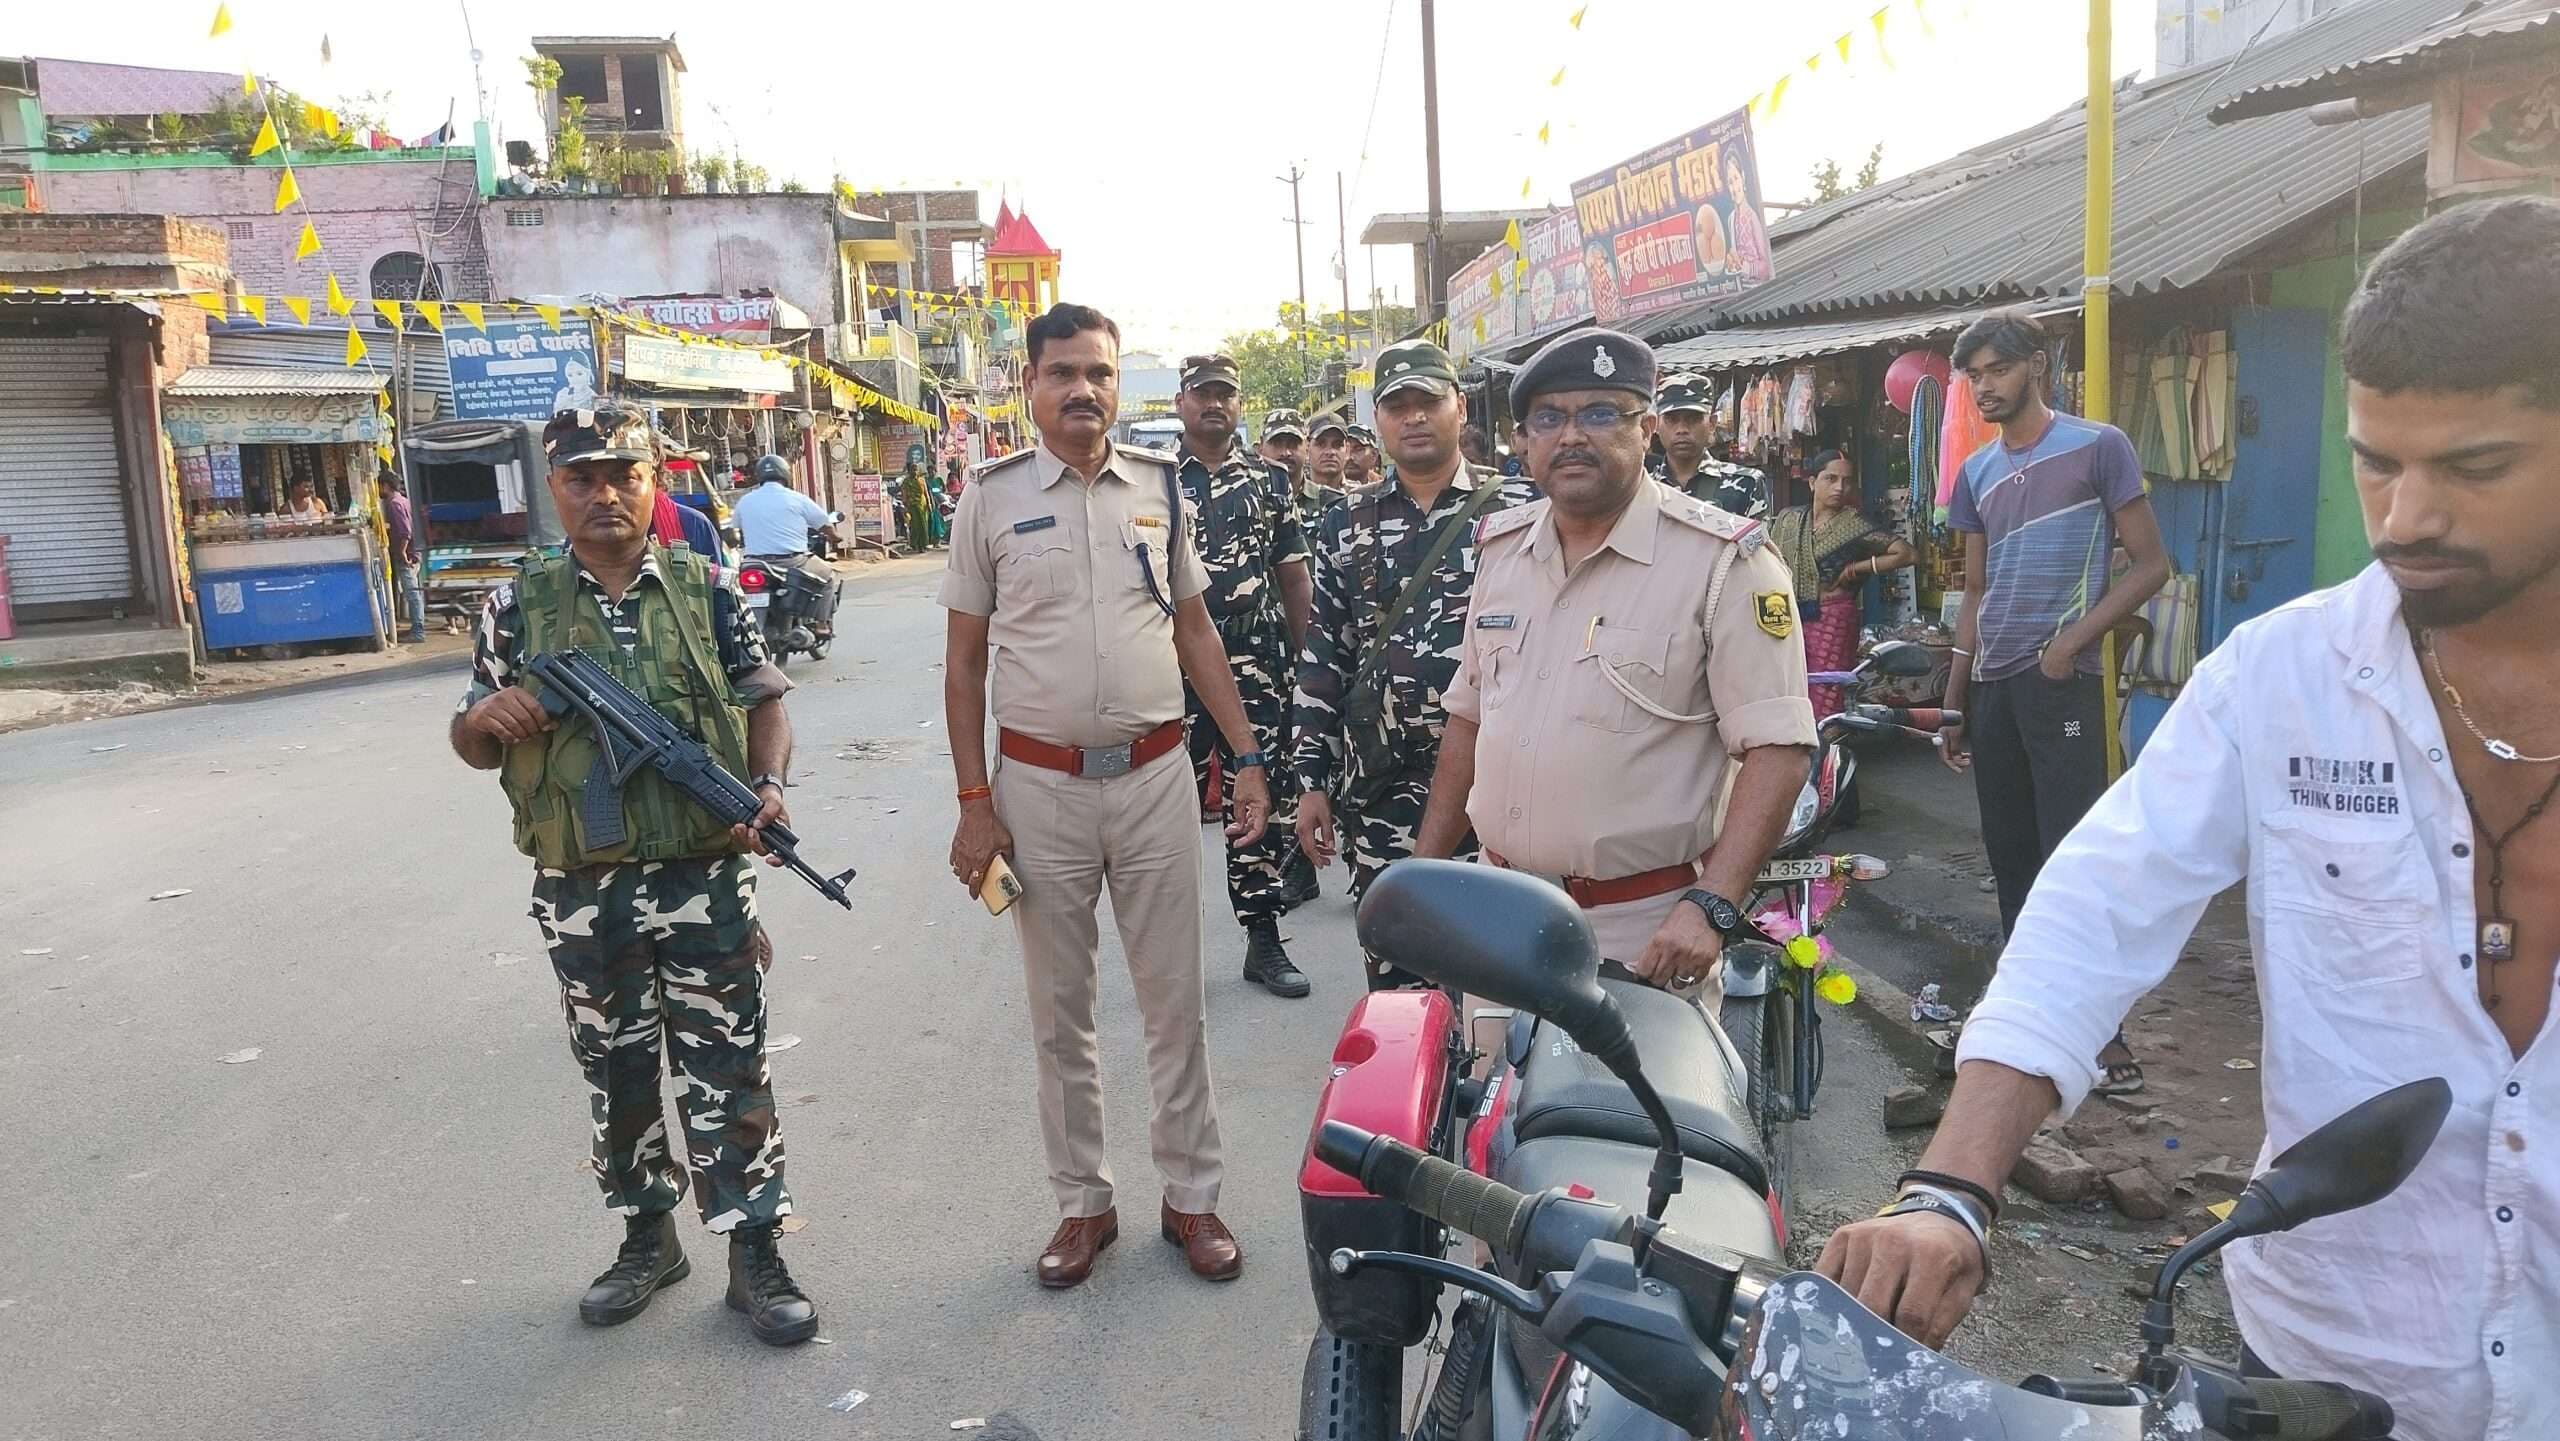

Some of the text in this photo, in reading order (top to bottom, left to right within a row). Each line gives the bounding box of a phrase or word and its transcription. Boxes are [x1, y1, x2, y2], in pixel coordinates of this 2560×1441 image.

[2289, 789, 2332, 810] THINK
[2335, 794, 2399, 814] BIGGER
[1780, 862, 1823, 876] 3522
